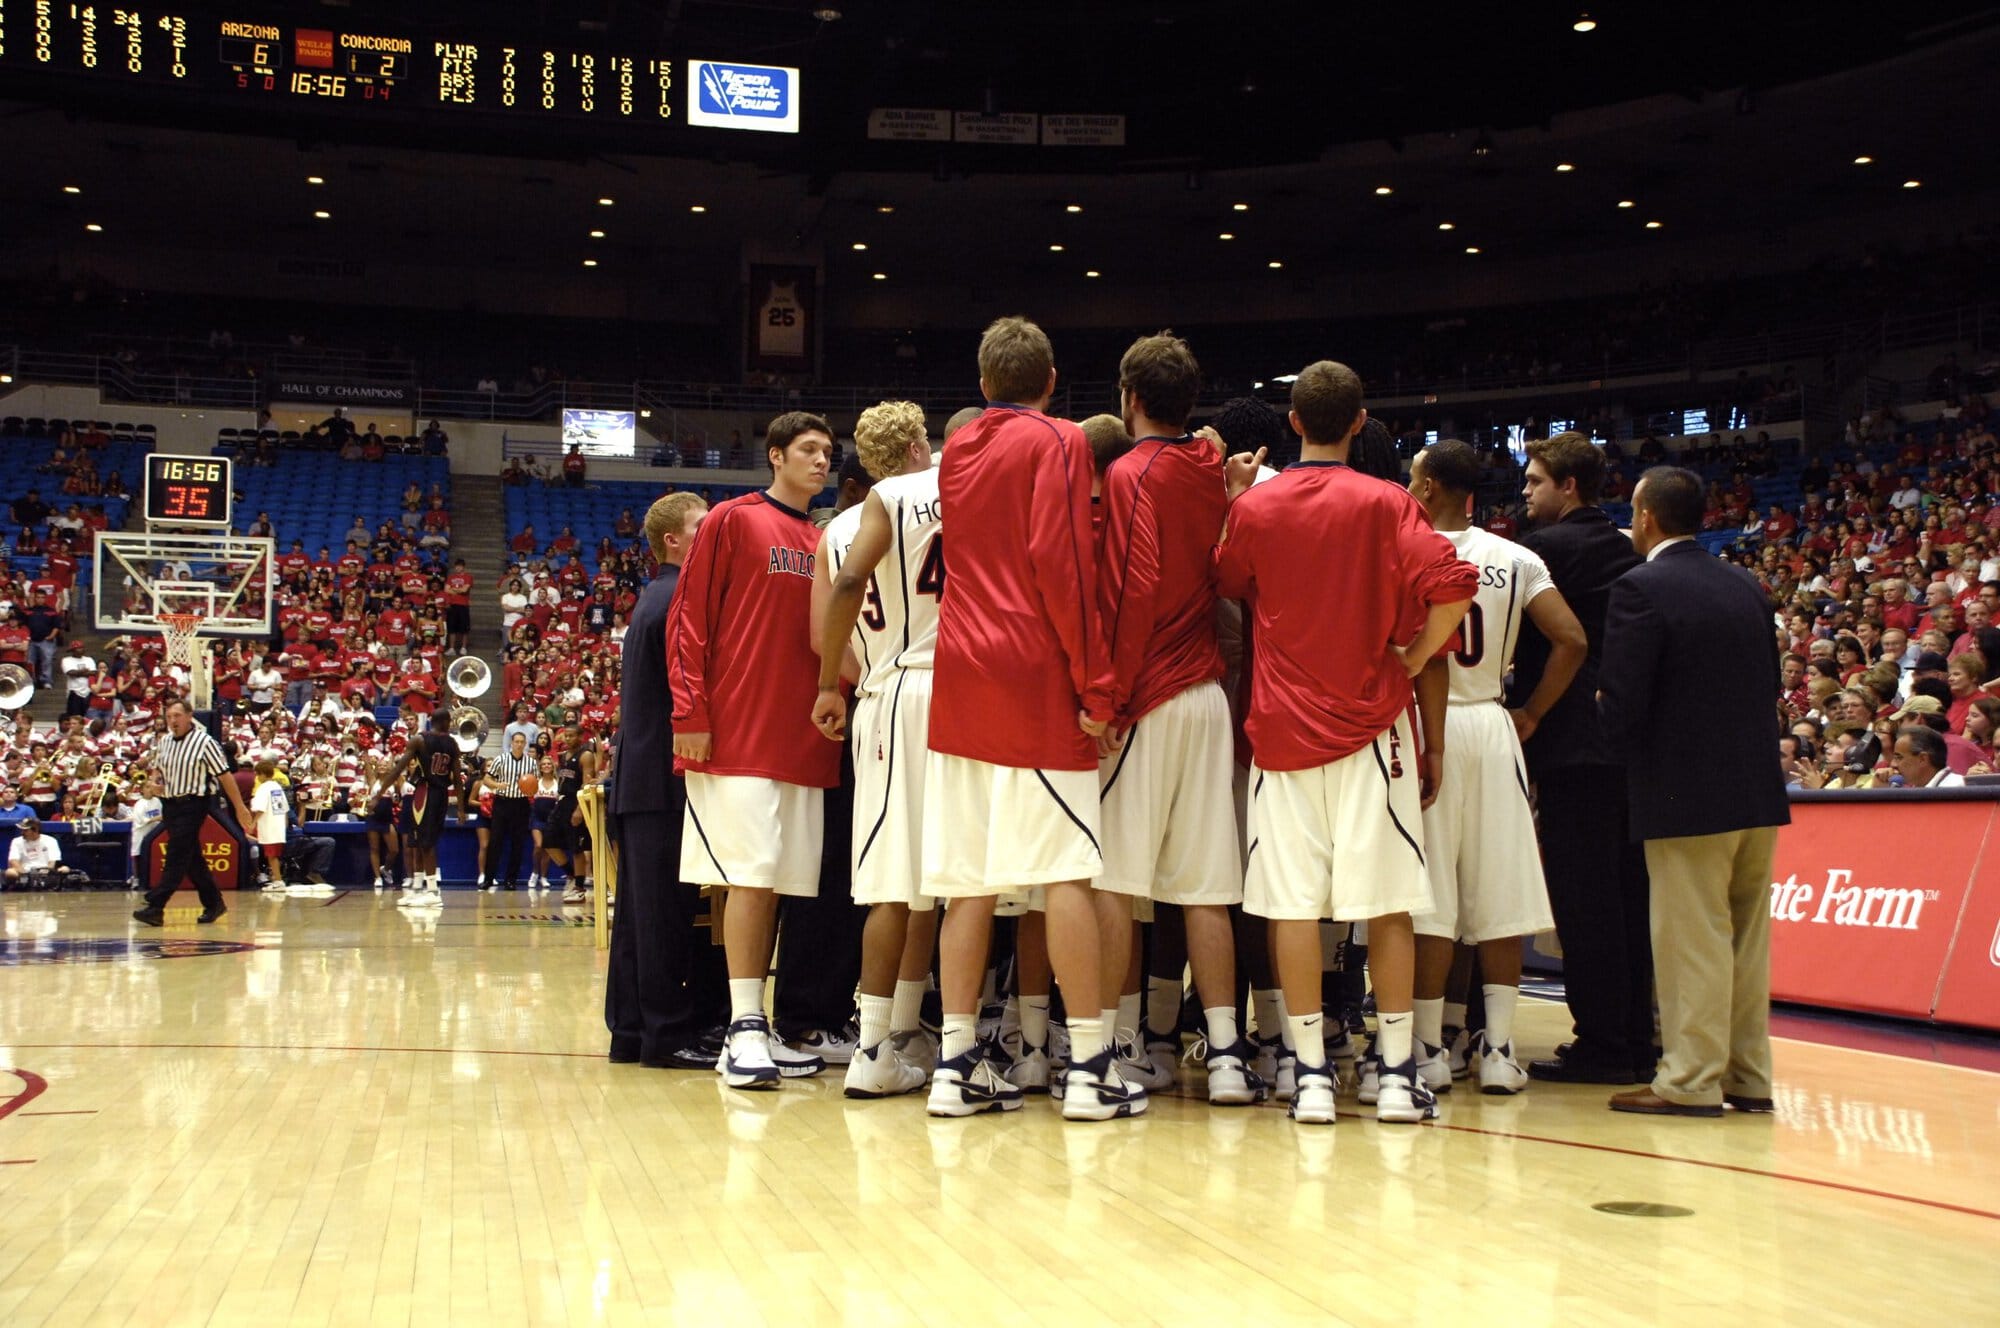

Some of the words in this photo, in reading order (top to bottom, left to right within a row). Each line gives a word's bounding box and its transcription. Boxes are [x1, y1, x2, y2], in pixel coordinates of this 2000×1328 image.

[36, 16, 50, 31] 0
[71, 4, 96, 21] 14
[114, 10, 141, 27] 34
[159, 16, 185, 32] 43
[221, 22, 280, 40] ARIZONA
[36, 31, 50, 46] 0
[127, 42, 141, 57] 0
[297, 39, 332, 50] WELLS
[341, 34, 412, 53] CONCORDIA
[36, 47, 50, 61] 0
[82, 52, 96, 67] 0
[127, 58, 141, 72] 0
[172, 63, 186, 77] 0
[254, 44, 268, 64] 6
[298, 48, 332, 59] FARGO
[435, 43, 477, 59] PLYR
[503, 48, 515, 62] 7
[611, 57, 633, 72] 12
[650, 61, 672, 75] 15
[380, 56, 394, 76] 2
[443, 58, 473, 73] PTS
[236, 74, 248, 88] 5
[264, 76, 275, 90] 0
[291, 73, 347, 97] 16:56
[440, 72, 474, 88] RBS
[720, 69, 771, 86] Tucson
[364, 85, 374, 99] 0
[379, 87, 390, 100] 4
[440, 87, 475, 103] FLS
[725, 82, 782, 99] Electric
[730, 95, 782, 113] Power
[768, 306, 796, 327] 25
[281, 383, 312, 394] HALL
[315, 385, 331, 395] OF
[334, 386, 404, 400] CHAMPIONS
[163, 462, 220, 481] 16:56
[165, 487, 209, 516] 35
[1478, 565, 1507, 589] SS
[72, 817, 103, 834] FSN
[1811, 868, 1925, 931] Farm
